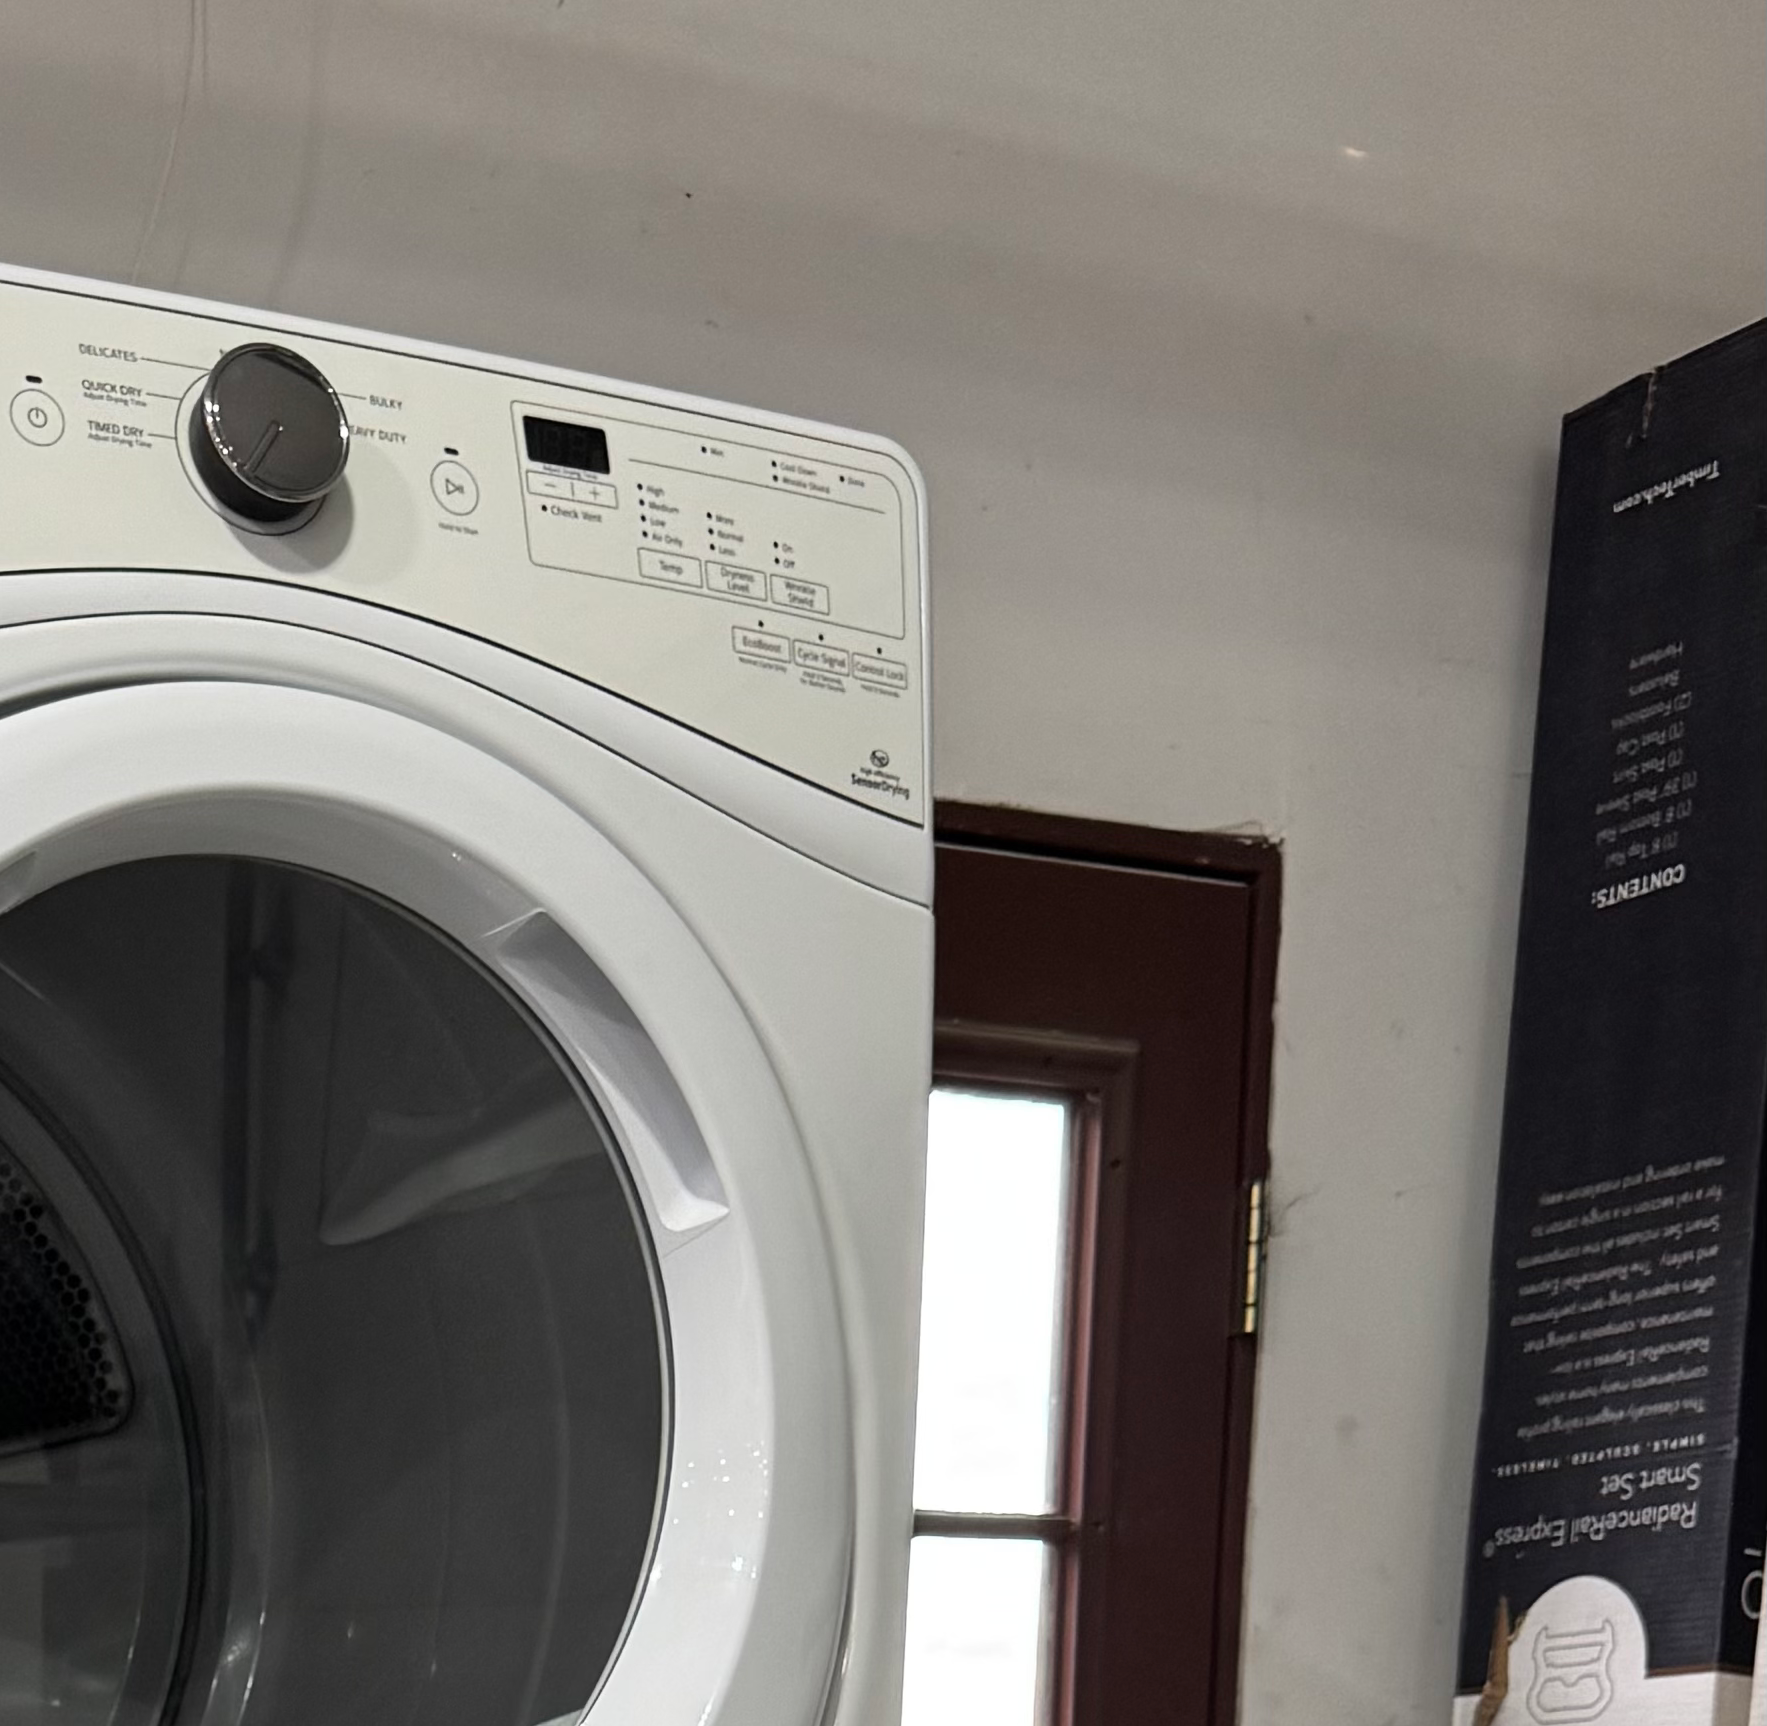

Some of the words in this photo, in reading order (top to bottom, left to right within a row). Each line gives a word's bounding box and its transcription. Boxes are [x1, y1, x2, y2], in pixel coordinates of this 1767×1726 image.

[79, 343, 138, 362] DELICATES
[82, 379, 117, 393] QUICK
[120, 385, 142, 397] DRY
[370, 395, 402, 410] BULKY
[87, 420, 120, 434] TIMED
[123, 425, 144, 437] DRY
[379, 430, 406, 444] DUTY
[1591, 864, 1686, 909] CONTENTS:
[1600, 1471, 1634, 1500] Set
[1640, 1462, 1703, 1491] Smart
[1571, 1501, 1698, 1543] RadianceRail
